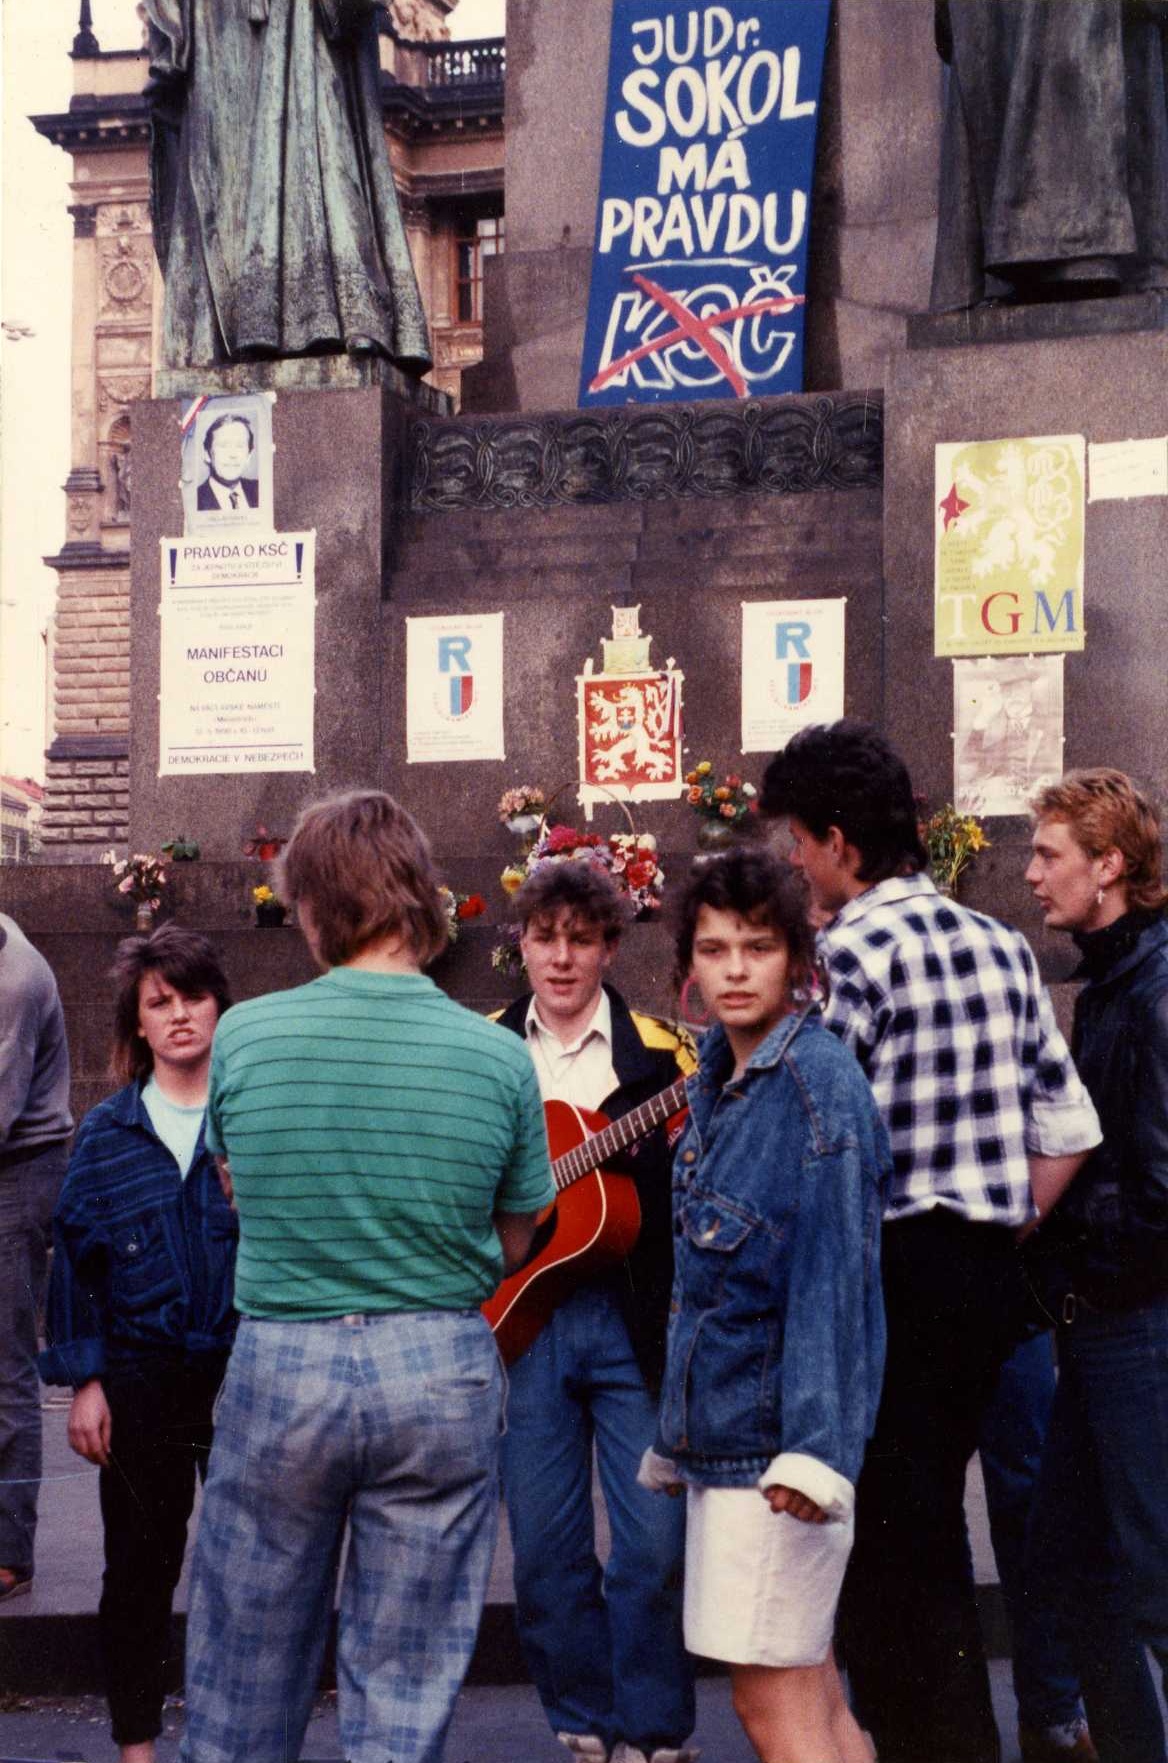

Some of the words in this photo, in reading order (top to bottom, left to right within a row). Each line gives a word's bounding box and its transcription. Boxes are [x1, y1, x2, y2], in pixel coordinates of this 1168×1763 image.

[631, 6, 760, 65] JUDr.
[614, 46, 817, 147] SOKOL
[657, 125, 752, 195] MÁ
[599, 189, 807, 257] PRAVDU
[183, 546, 240, 560] PRAVDA
[243, 544, 254, 557] O
[258, 541, 289, 557] KSČ
[775, 622, 812, 660] R
[939, 588, 1078, 641] TGM
[187, 644, 284, 660] MANIFESTACI
[437, 636, 473, 673] R
